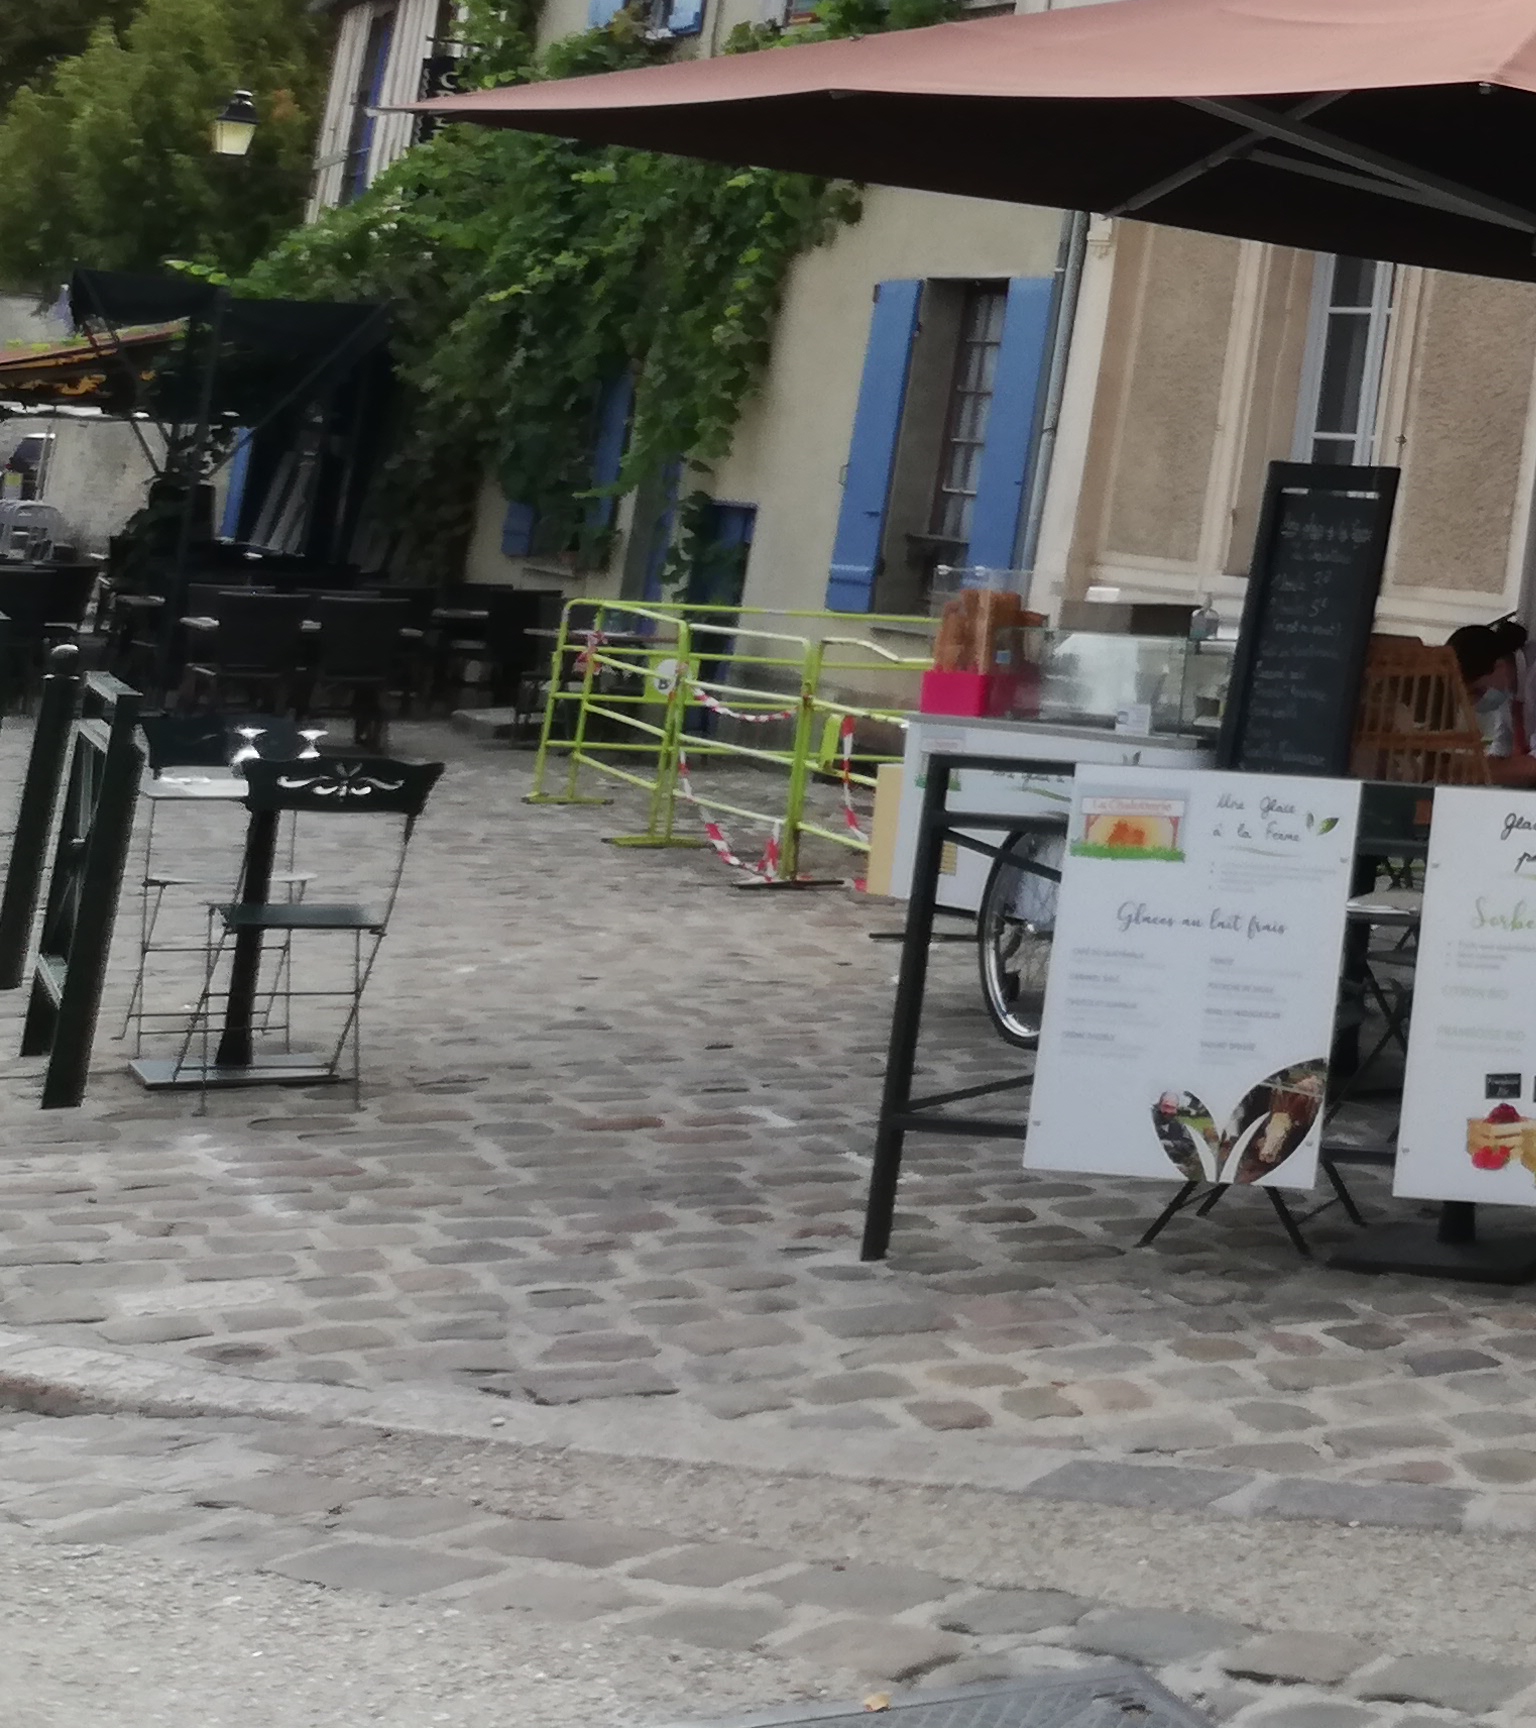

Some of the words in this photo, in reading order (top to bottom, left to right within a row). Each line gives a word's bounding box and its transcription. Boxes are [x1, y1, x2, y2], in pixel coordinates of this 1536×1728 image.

[1237, 824, 1252, 840] la
[1117, 901, 1173, 932] Glaces
[1182, 917, 1202, 928] au
[1209, 907, 1242, 931] lait
[1247, 914, 1288, 940] frais
